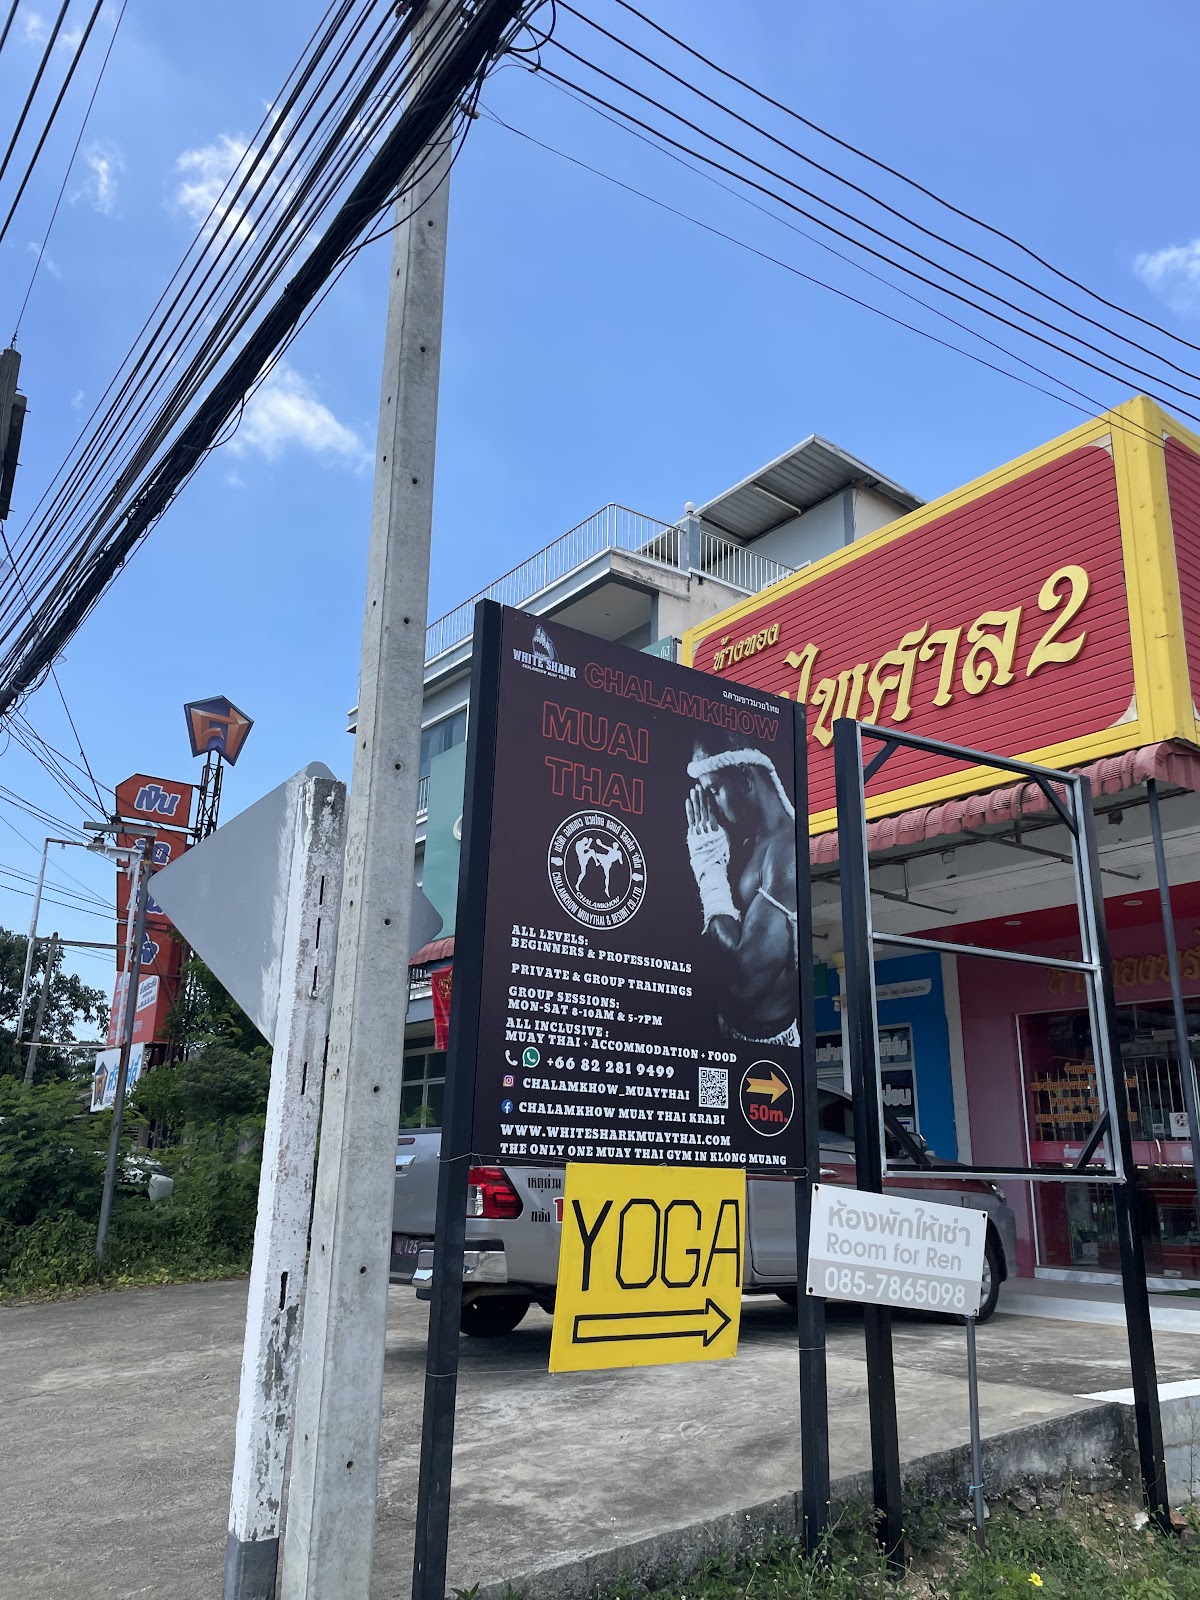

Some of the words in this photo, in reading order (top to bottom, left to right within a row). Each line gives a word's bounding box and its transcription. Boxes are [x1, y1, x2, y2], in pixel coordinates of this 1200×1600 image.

[1026, 564, 1091, 677] 2
[712, 622, 780, 671] ห้างทอง
[512, 648, 544, 669] WHITE
[546, 660, 577, 679] SHARK
[585, 662, 780, 742] CHALAMKHOW
[542, 701, 649, 764] MUAI
[545, 756, 644, 815] THAI
[551, 871, 580, 914] CHALAMKHOW
[576, 907, 606, 926] MUAYTHAI
[576, 891, 620, 909] CHALAMKHOW
[511, 924, 536, 938] ALL
[539, 928, 589, 946] LEVELS:
[511, 937, 584, 958] BEGINNERS
[587, 949, 596, 959] &
[598, 949, 692, 973] PROFESSIONALS
[511, 962, 570, 981] PRIVATE
[572, 971, 581, 982] &
[583, 973, 625, 988] GROUP
[627, 978, 693, 997] TRAININGS
[507, 998, 569, 1015] MON-SAT
[571, 1007, 615, 1020] 8-10AM
[617, 1011, 625, 1022] &
[628, 1013, 663, 1026] 5-7PM
[508, 985, 554, 1000] GROUP
[557, 991, 620, 1009] SESSIONS:
[505, 1017, 531, 1029] ALL
[534, 1019, 603, 1037] INCLUSIVE
[505, 1030, 545, 1044] MUAY
[548, 1034, 581, 1048] THAI
[591, 1038, 698, 1059] ACCOMMODATION
[707, 1050, 737, 1063] FOOD
[547, 1056, 576, 1070] +66
[580, 1058, 601, 1073] 82
[605, 1060, 632, 1075] 281
[636, 1063, 675, 1078] 9499
[522, 1078, 690, 1100] CHALAMKHOW_MUAYTHAI
[518, 1102, 615, 1118] CHALAMKHOW
[618, 1108, 654, 1120] MUAY
[657, 1110, 687, 1123] THAI
[689, 1112, 725, 1125] KRABI
[749, 1103, 788, 1123] 50m.
[500, 1123, 731, 1146] WWW.WHITESHARKMUAYTHAI.COM
[500, 1142, 527, 1154] THE
[529, 1143, 565, 1156] ONLY
[567, 1145, 594, 1157] ONE
[596, 1146, 632, 1158] MUAY
[634, 1148, 664, 1160] THAI
[666, 1149, 692, 1161] GYM
[695, 1151, 707, 1162] IN
[710, 1151, 747, 1163] KLONG
[748, 1153, 787, 1165] MUANG
[528, 1173, 562, 1193] เหตุด่วน
[828, 1199, 971, 1247] ห้องพักให้เช่า
[572, 1198, 742, 1292] YOGA
[826, 1232, 887, 1261] Room
[893, 1242, 920, 1266] for
[926, 1247, 962, 1272] Ren
[824, 1266, 966, 1309] 085-7865098
